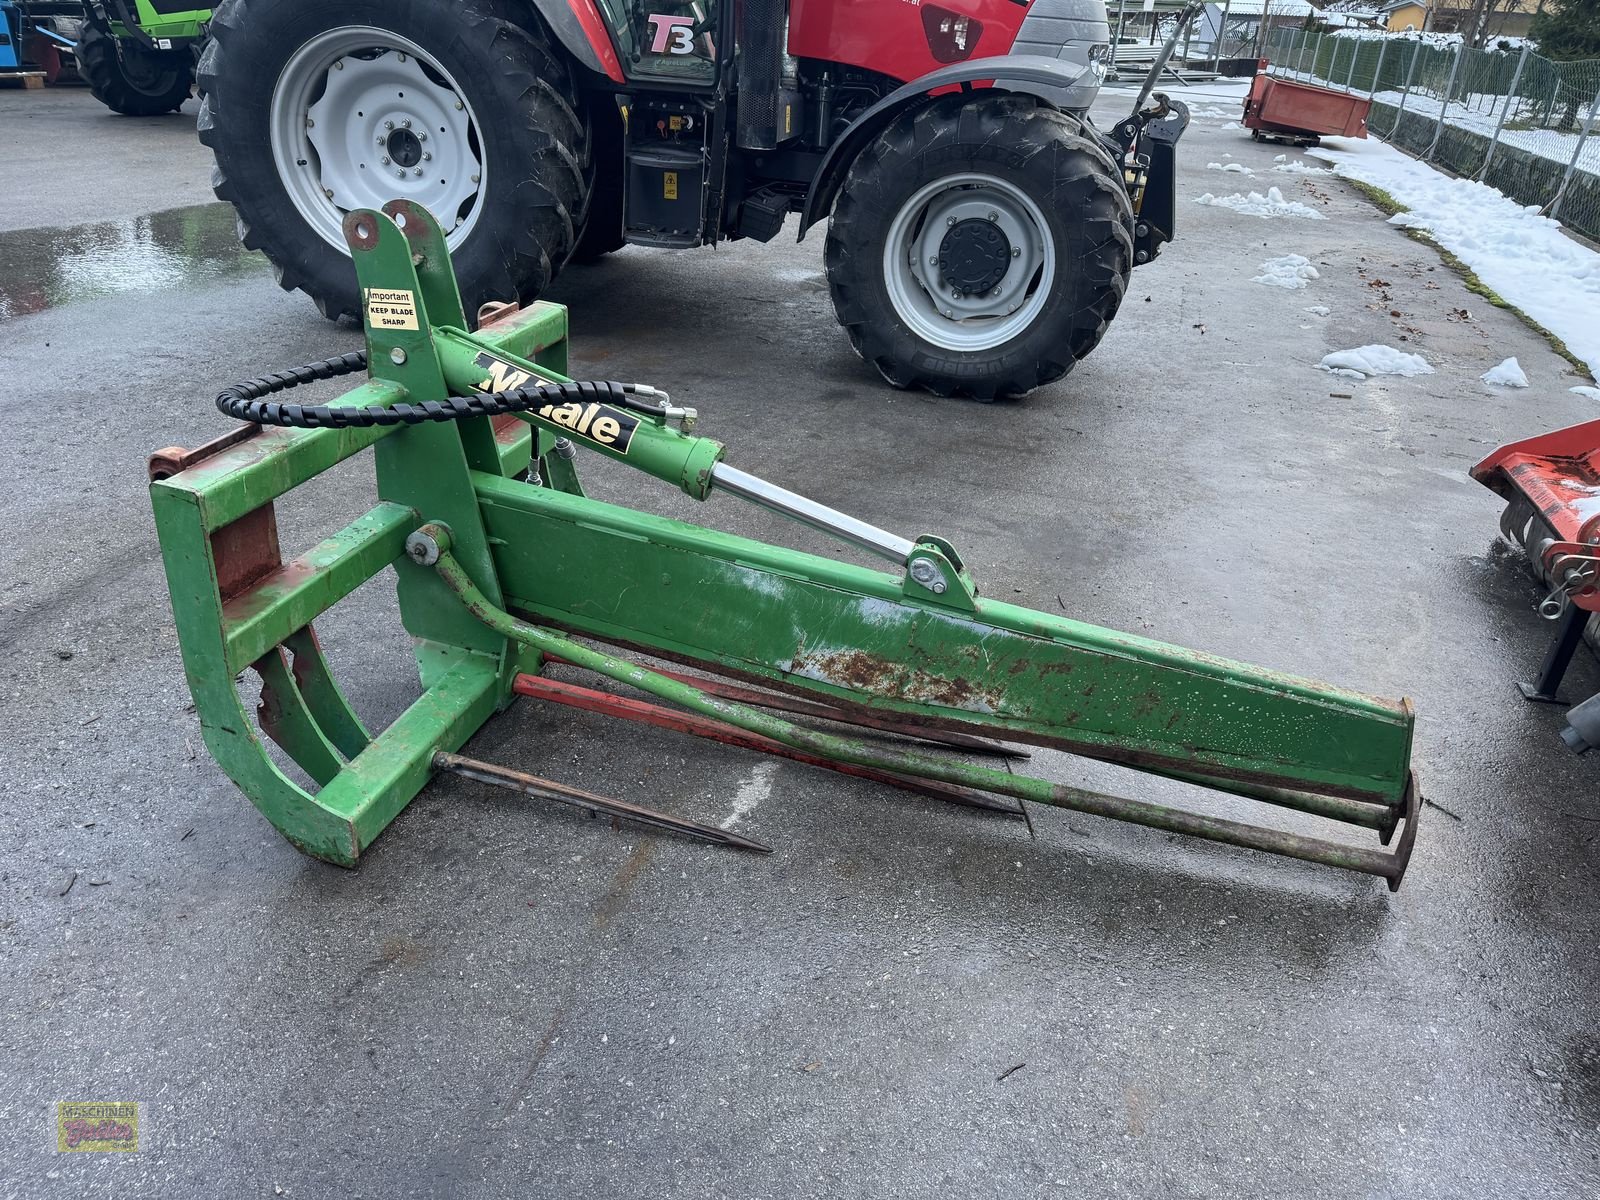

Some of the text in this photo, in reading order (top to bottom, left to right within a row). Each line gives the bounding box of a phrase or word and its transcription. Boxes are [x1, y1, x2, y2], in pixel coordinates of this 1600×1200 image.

[648, 13, 695, 55] T3
[381, 318, 406, 327] SHARP
[390, 308, 414, 316] BLADE
[479, 360, 621, 444] Male
